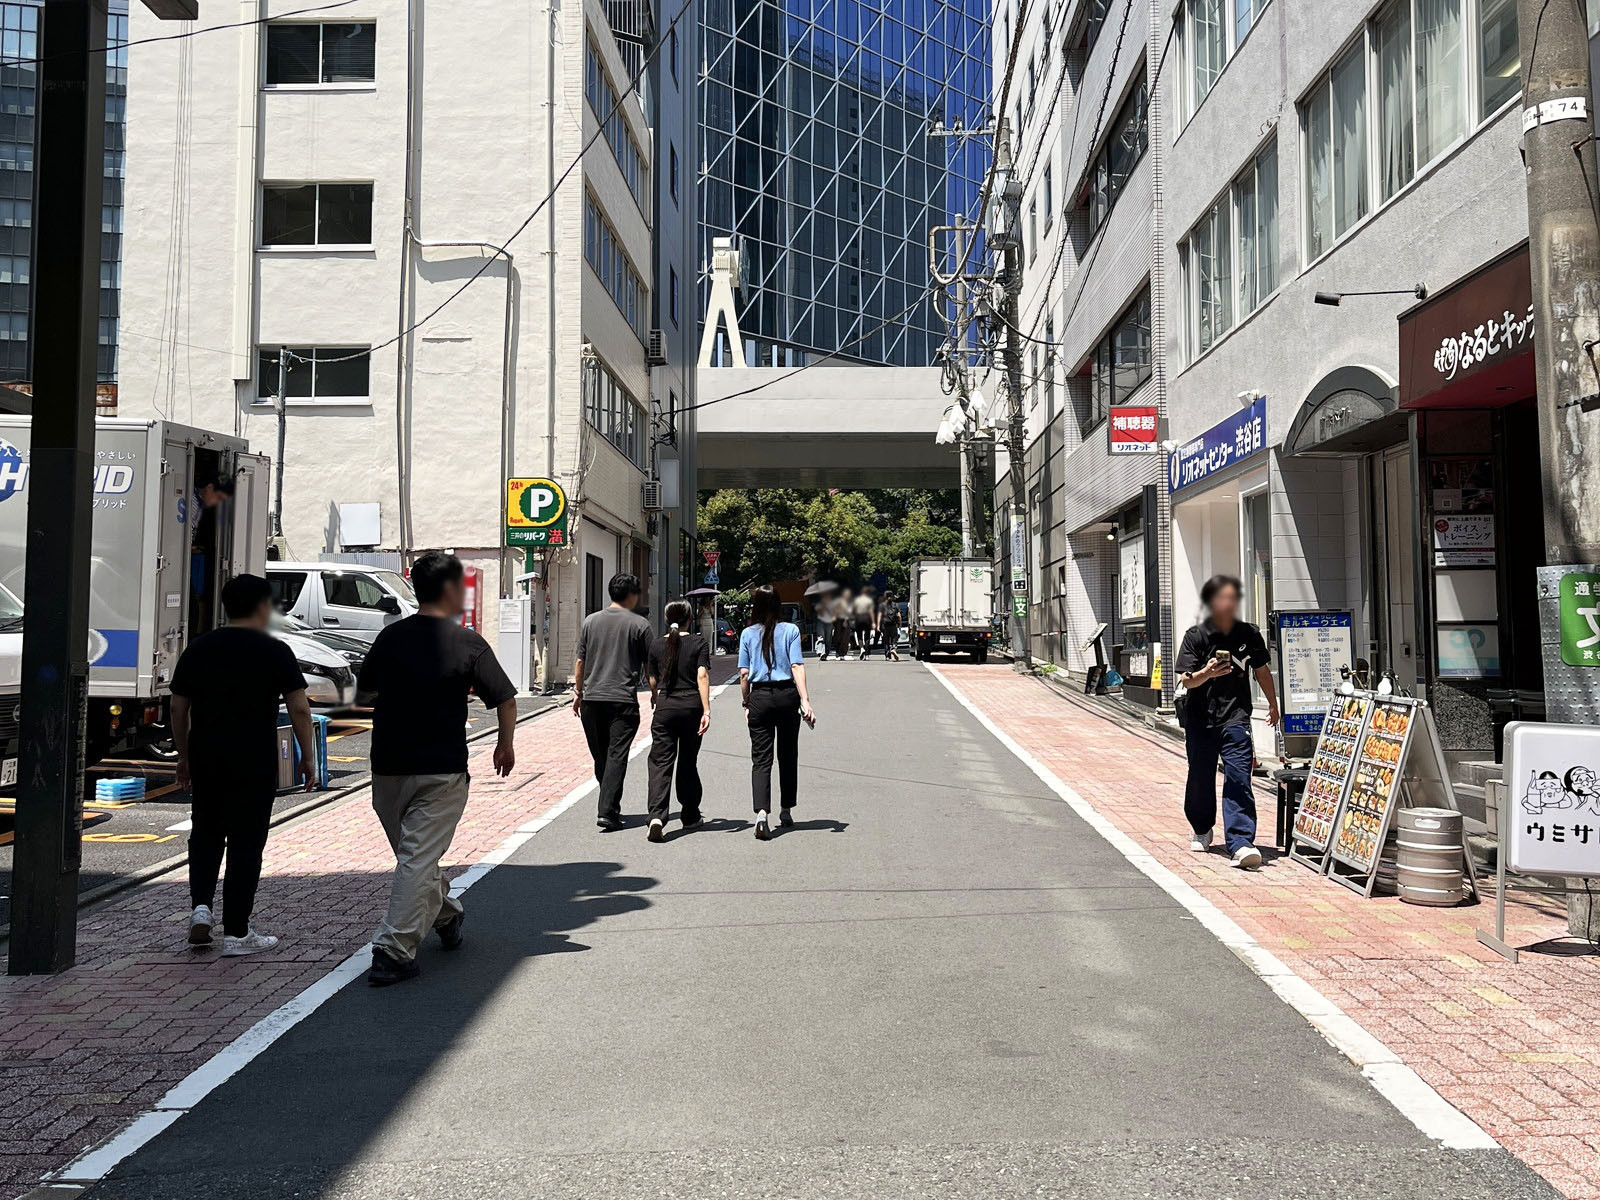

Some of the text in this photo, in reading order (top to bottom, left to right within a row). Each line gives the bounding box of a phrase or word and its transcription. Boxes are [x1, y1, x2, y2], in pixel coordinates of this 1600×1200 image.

[1113, 416, 1155, 430] 補聴器
[1182, 442, 1234, 485] リオネットセンター
[1235, 416, 1261, 457] 渋谷店
[530, 488, 554, 518] P
[1453, 524, 1478, 532] ボイス
[510, 529, 563, 544] 三井のリパーク 満
[1443, 532, 1491, 541] トレーニング
[1527, 822, 1600, 844] ウミサ
